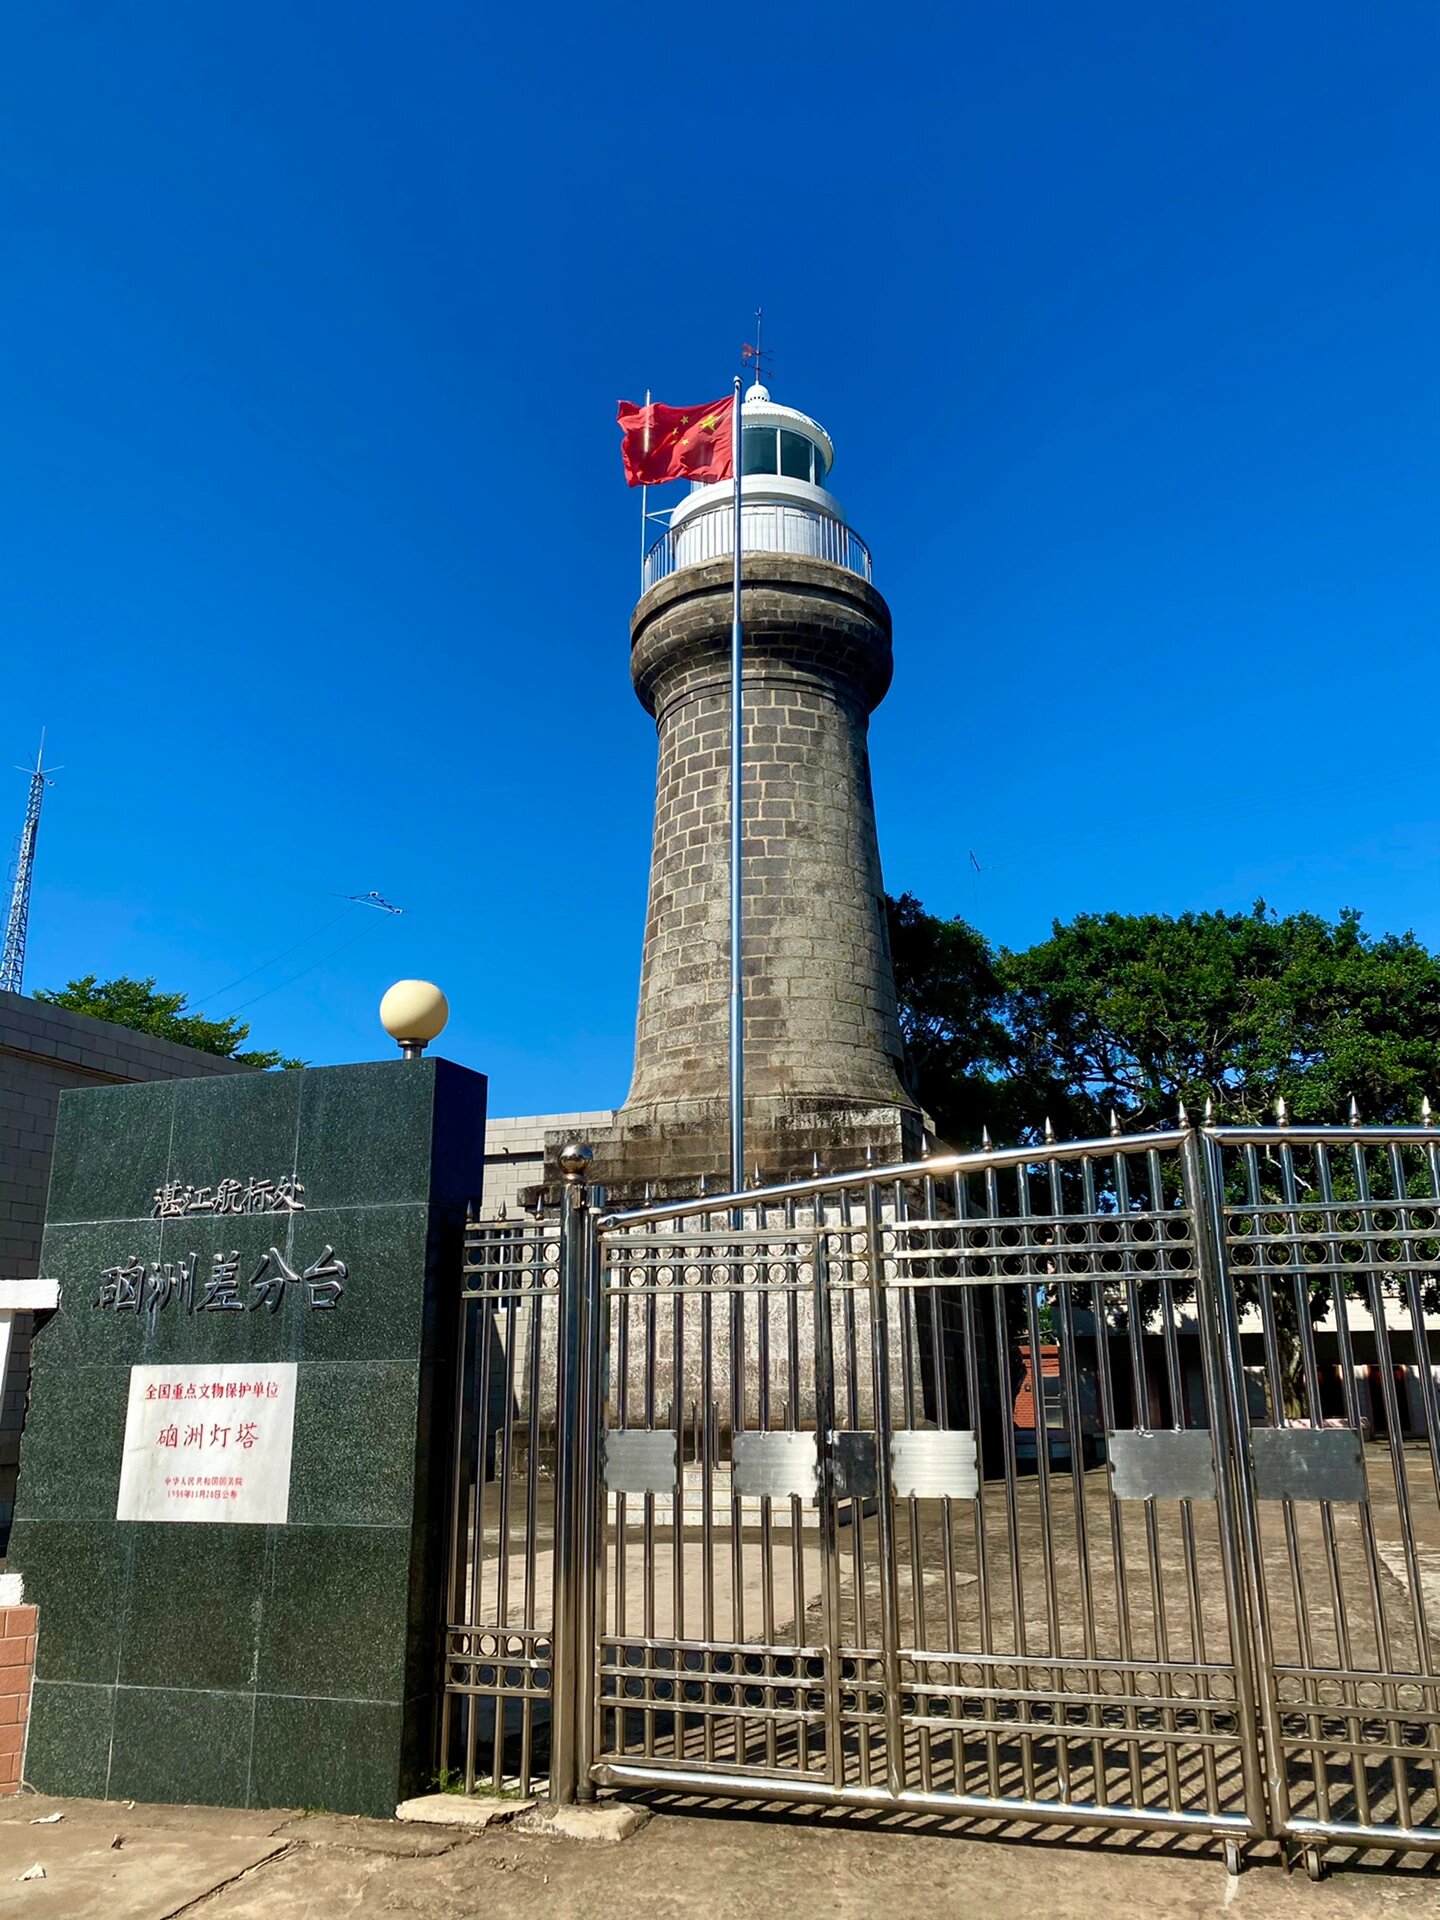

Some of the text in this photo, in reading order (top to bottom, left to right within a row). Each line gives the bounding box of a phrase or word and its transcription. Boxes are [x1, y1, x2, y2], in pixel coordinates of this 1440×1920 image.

[153, 1175, 306, 1218] 湛江航标处
[145, 1381, 279, 1400] 全国重点文物保护单位
